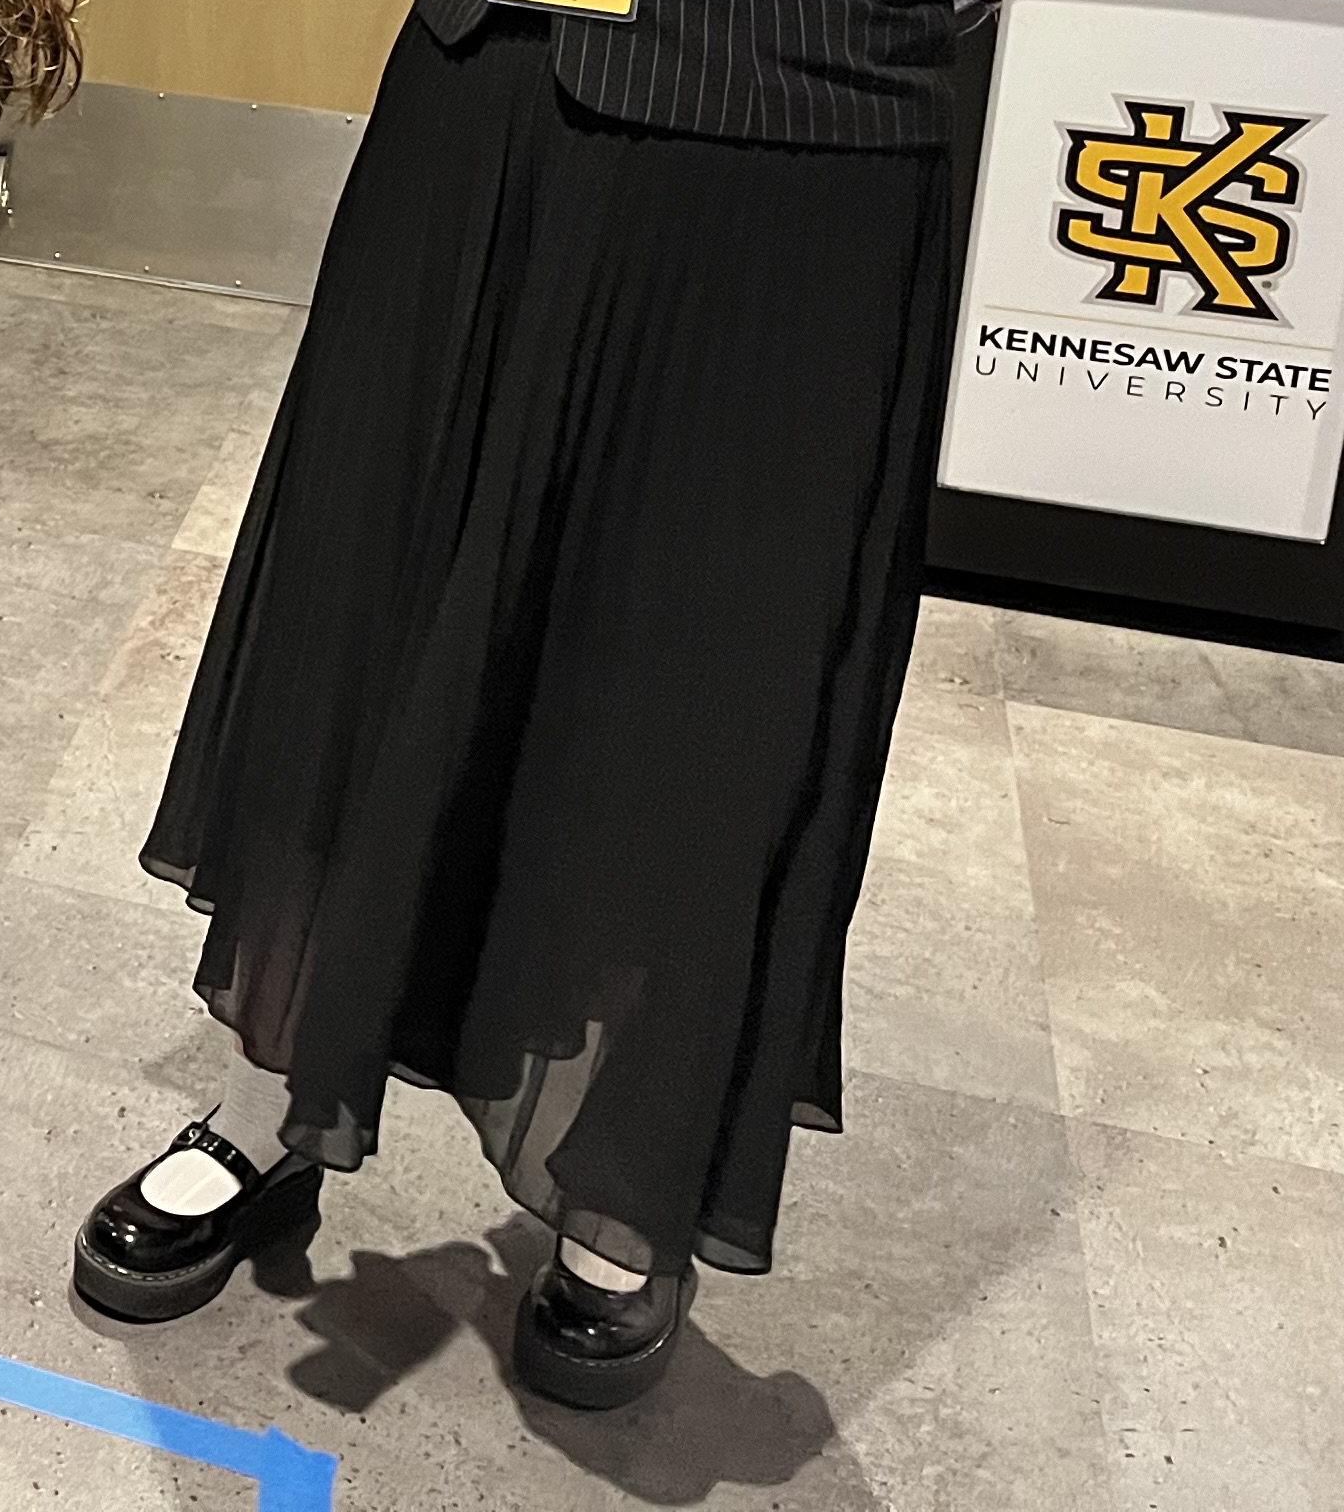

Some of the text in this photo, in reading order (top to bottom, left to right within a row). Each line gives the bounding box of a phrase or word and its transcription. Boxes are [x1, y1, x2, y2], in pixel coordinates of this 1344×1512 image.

[975, 355, 1327, 421] UNIVERSITY
[979, 325, 1333, 392] KENNESAW STATE
